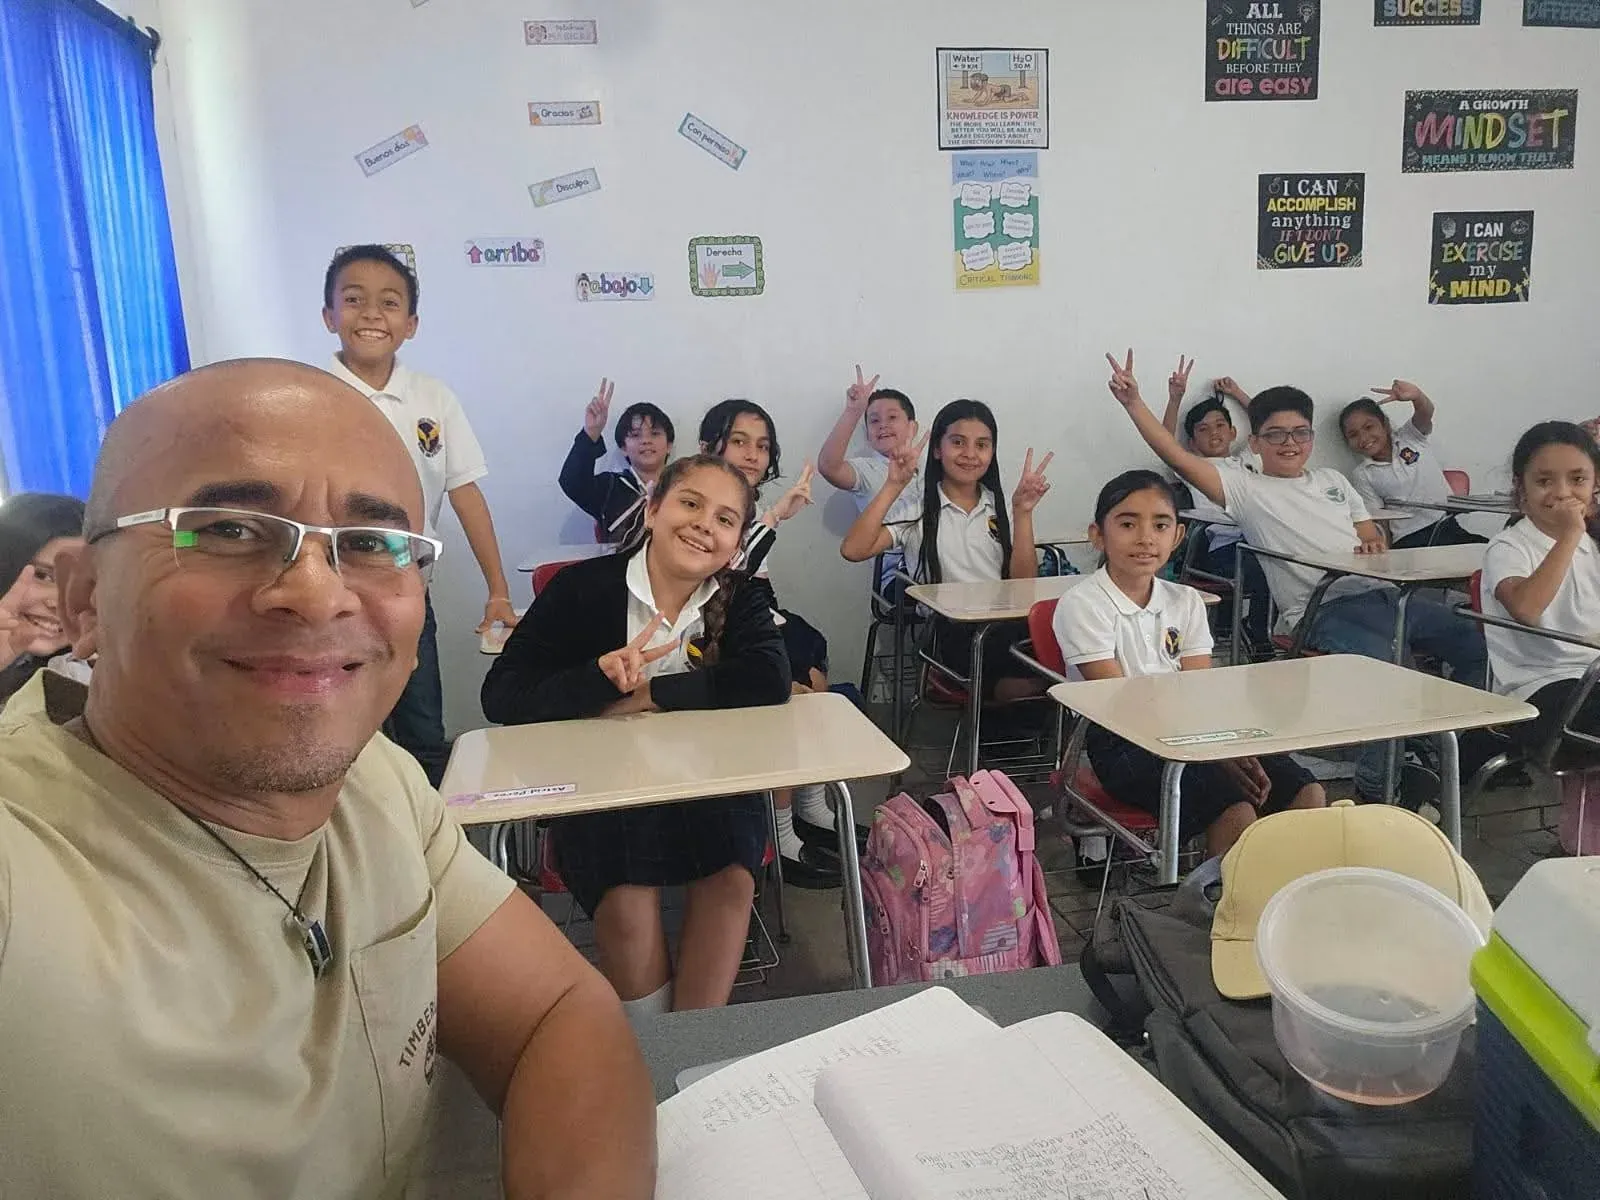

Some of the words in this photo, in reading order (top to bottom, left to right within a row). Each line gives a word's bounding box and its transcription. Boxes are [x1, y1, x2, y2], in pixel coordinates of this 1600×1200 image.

[1246, 2, 1283, 19] ALL
[1383, 0, 1475, 17] SUCCESS
[1226, 22, 1274, 35] THINGS
[1277, 22, 1302, 35] ARE
[1216, 36, 1312, 60] DIFFICULT
[952, 54, 980, 62] Water
[1226, 63, 1270, 74] BEFORE
[1273, 62, 1303, 73] THEY
[1215, 78, 1254, 95] are
[1259, 77, 1313, 95] easy
[1459, 100, 1470, 110] A
[1473, 99, 1529, 110] GROWTH
[541, 108, 575, 118] Gracias
[946, 111, 999, 121] KNOWLEDGE
[1000, 111, 1008, 120] IS
[1010, 111, 1039, 120] POWER
[688, 122, 702, 136] Con
[1415, 109, 1569, 150] MINDSET
[1422, 153, 1466, 165] MEANS
[1469, 153, 1475, 164] I
[1478, 153, 1520, 164] KNOW
[1520, 152, 1556, 163] THAT
[556, 179, 589, 193] Disculpa
[1283, 180, 1290, 196] I
[1297, 179, 1340, 196] CAN
[1266, 197, 1356, 212] ACCOMPLISH
[1271, 212, 1352, 230] anything
[1280, 230, 1294, 241] IF
[1465, 223, 1471, 238] I
[1473, 222, 1504, 237] CAN
[484, 241, 540, 263] arriba
[706, 247, 743, 257] Derecha
[1274, 241, 1316, 264] GIVE
[1322, 242, 1350, 263] UP
[1442, 240, 1524, 263] EXERCISE
[1468, 264, 1497, 278] my
[590, 273, 637, 297] abajo
[1449, 279, 1511, 298] MIND
